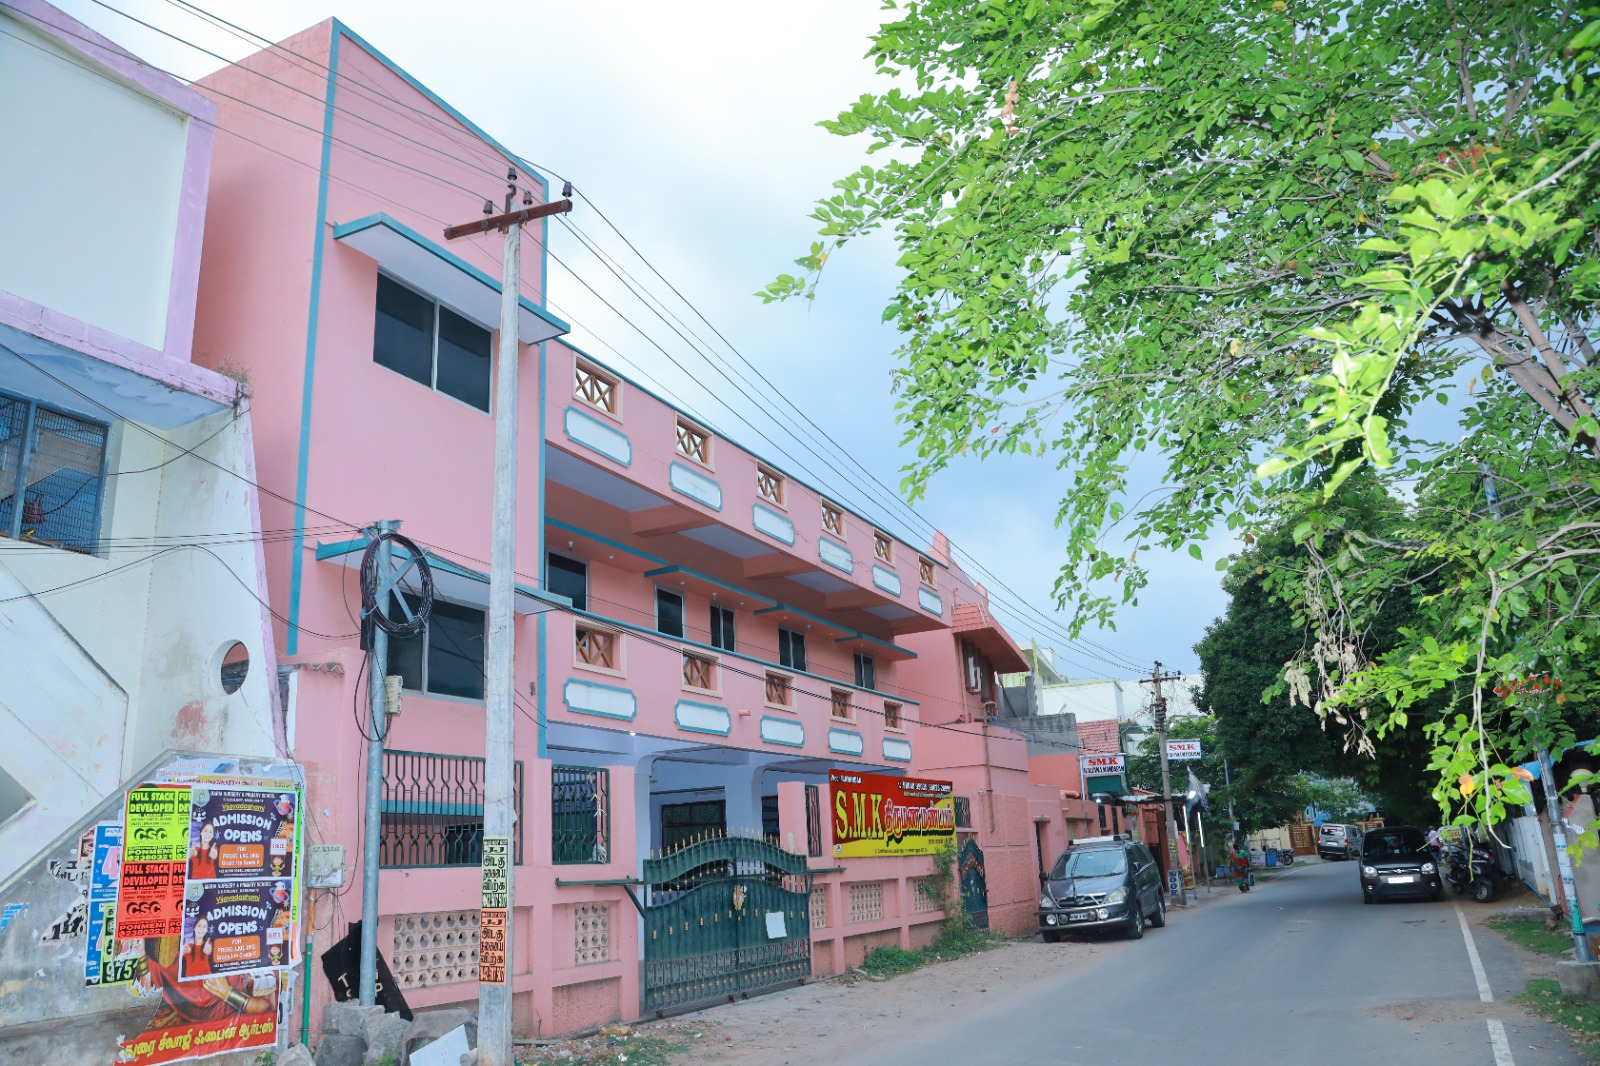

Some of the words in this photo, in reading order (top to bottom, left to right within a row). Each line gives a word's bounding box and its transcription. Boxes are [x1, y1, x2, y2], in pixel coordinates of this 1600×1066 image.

[131, 792, 149, 801] FULL
[151, 792, 175, 801] STACK
[130, 803, 174, 813] DEVELOPER
[835, 789, 884, 839] S.M.K
[212, 814, 272, 830] ADMISSION
[134, 828, 167, 841] CSC
[224, 829, 262, 843] OPENS
[124, 864, 144, 874] FULL
[145, 863, 170, 874] STACK
[123, 876, 168, 886] DEVELOPER
[126, 901, 161, 916] CSC
[206, 904, 268, 921] ADMISSION
[120, 921, 166, 931] PONMENI
[217, 920, 258, 935] OPENS
